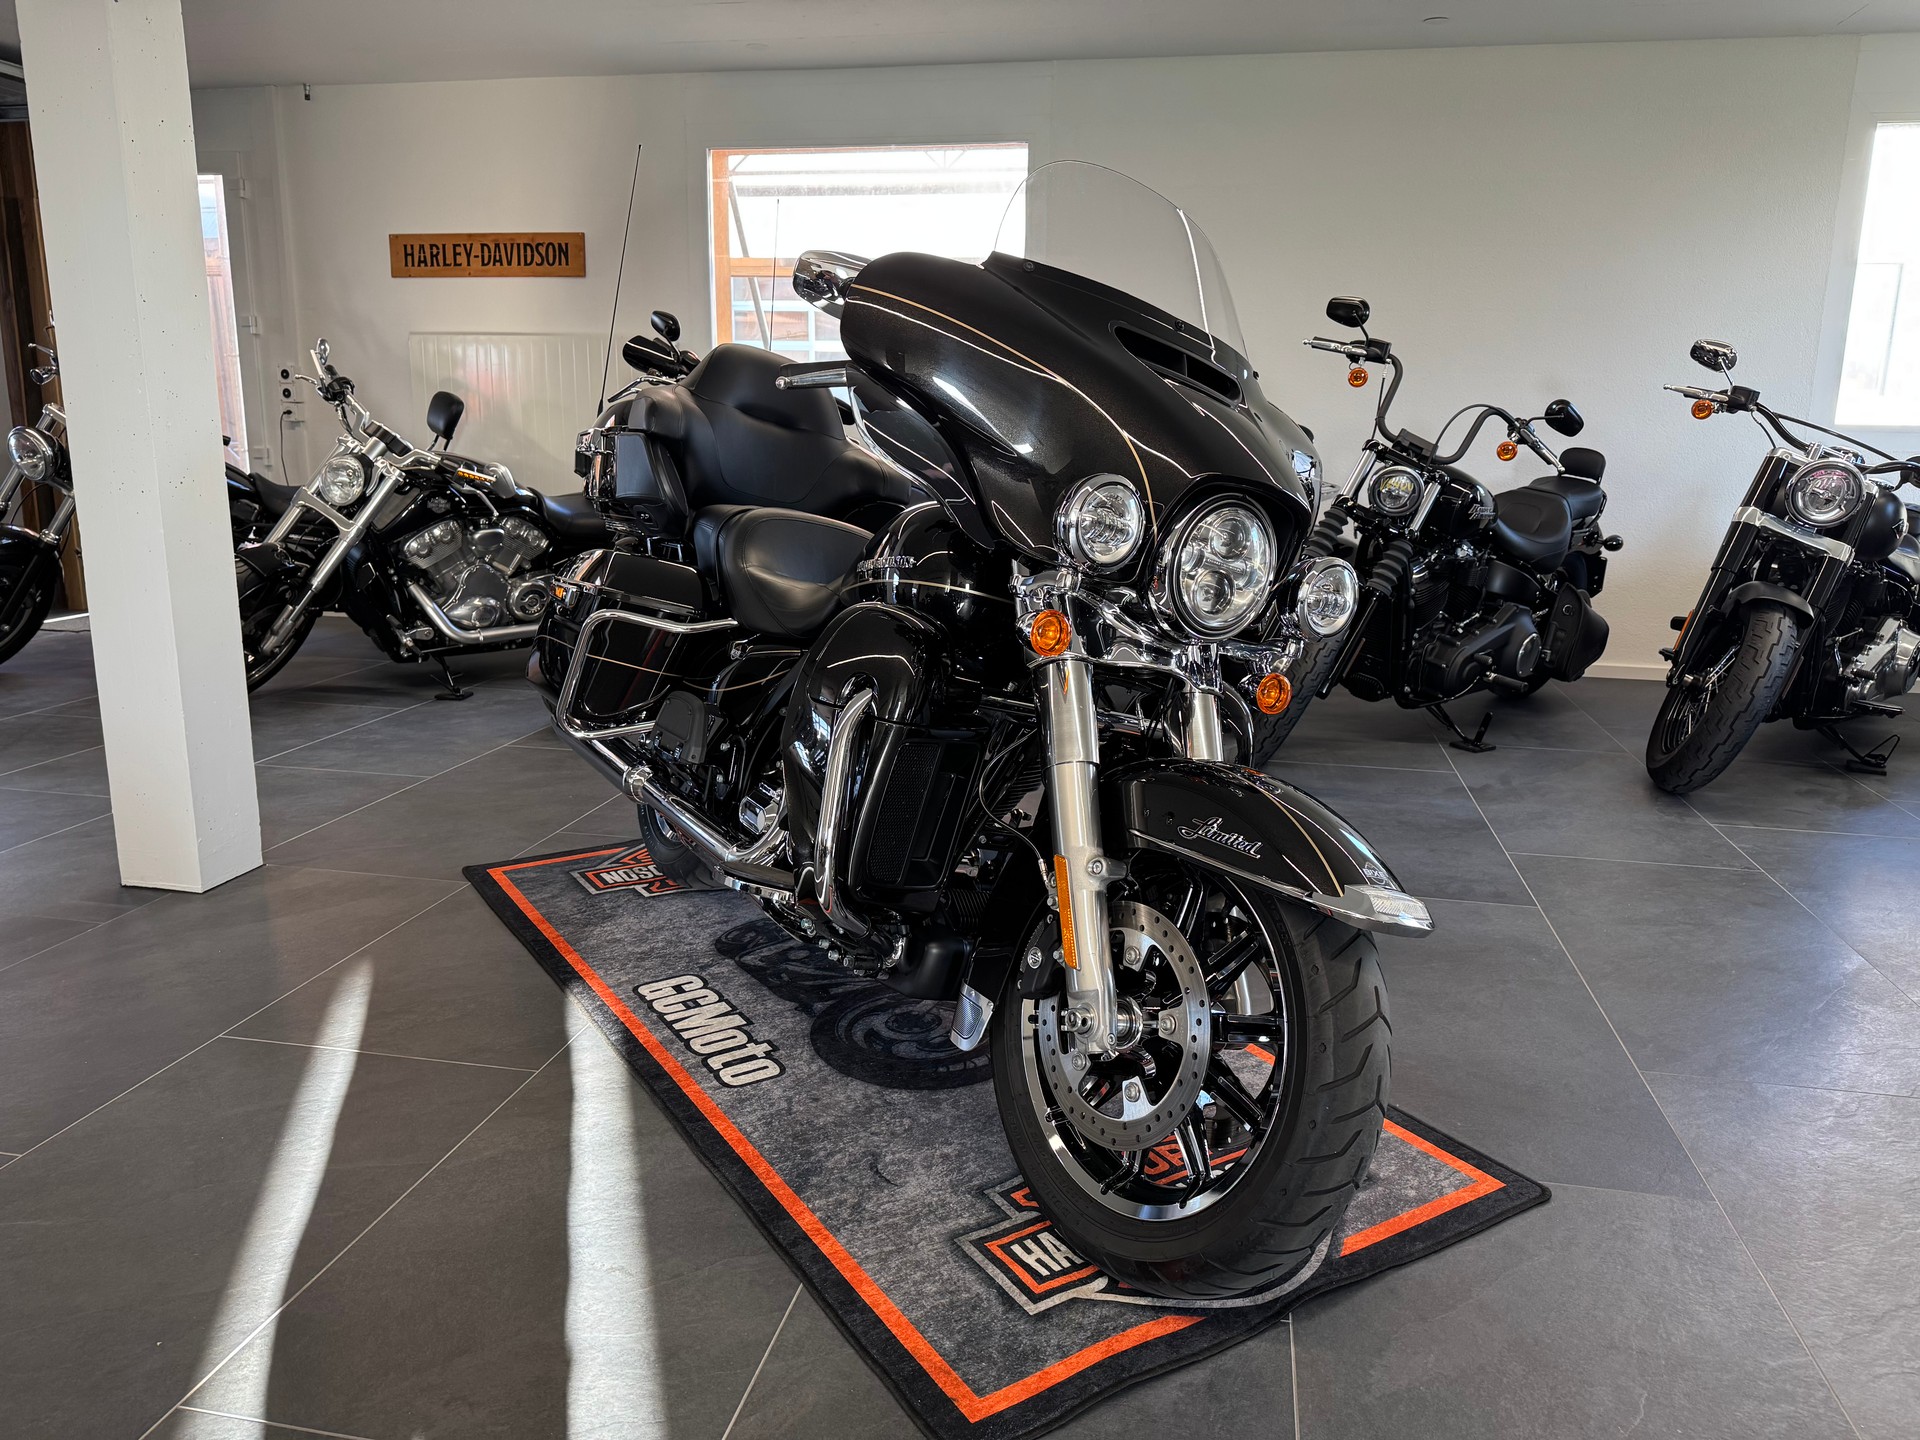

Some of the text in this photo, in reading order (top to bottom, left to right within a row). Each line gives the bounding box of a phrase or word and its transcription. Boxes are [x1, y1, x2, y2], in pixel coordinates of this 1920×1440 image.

[403, 241, 570, 268] HARLEY-DAVIDSON
[1177, 816, 1263, 859] Limited
[635, 974, 784, 1087] GCMoto
